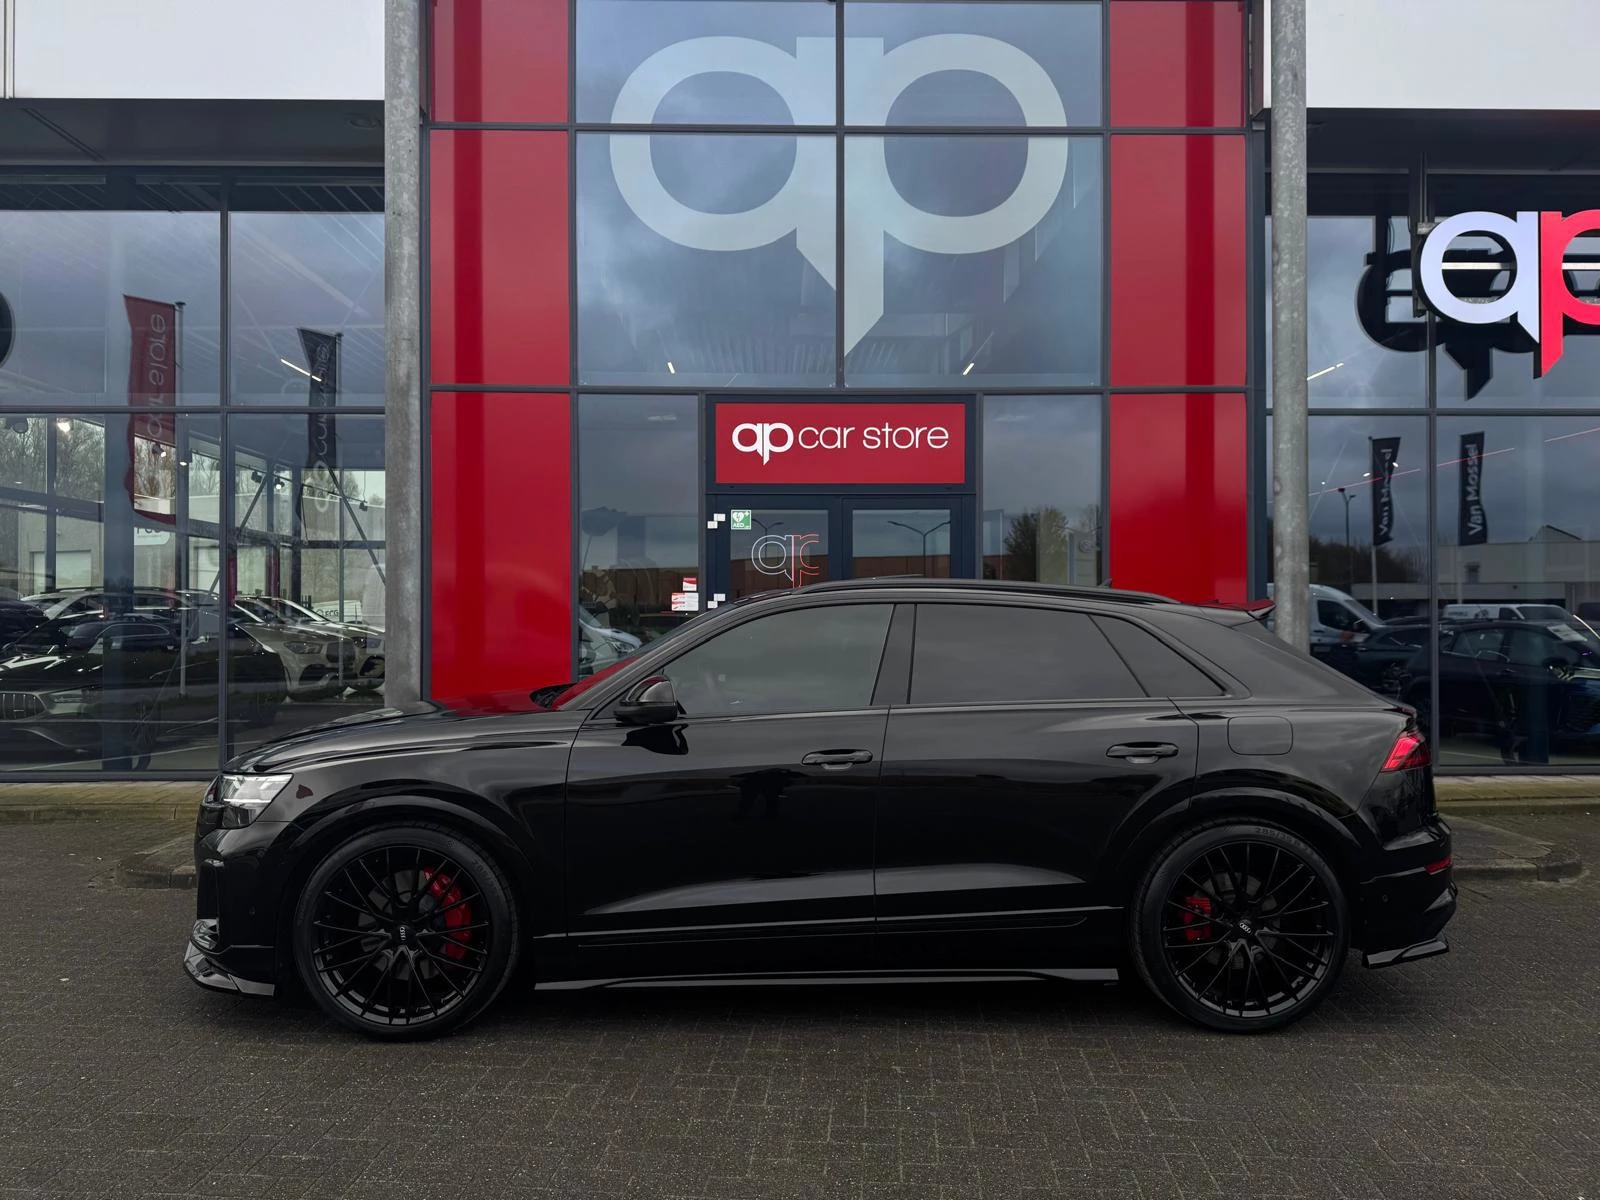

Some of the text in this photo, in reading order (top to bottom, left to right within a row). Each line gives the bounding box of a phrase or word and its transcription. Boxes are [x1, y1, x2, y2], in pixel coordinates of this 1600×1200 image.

[609, 33, 1069, 357] ap
[731, 421, 949, 466] ap car store
[1465, 444, 1482, 535] Van Mossel
